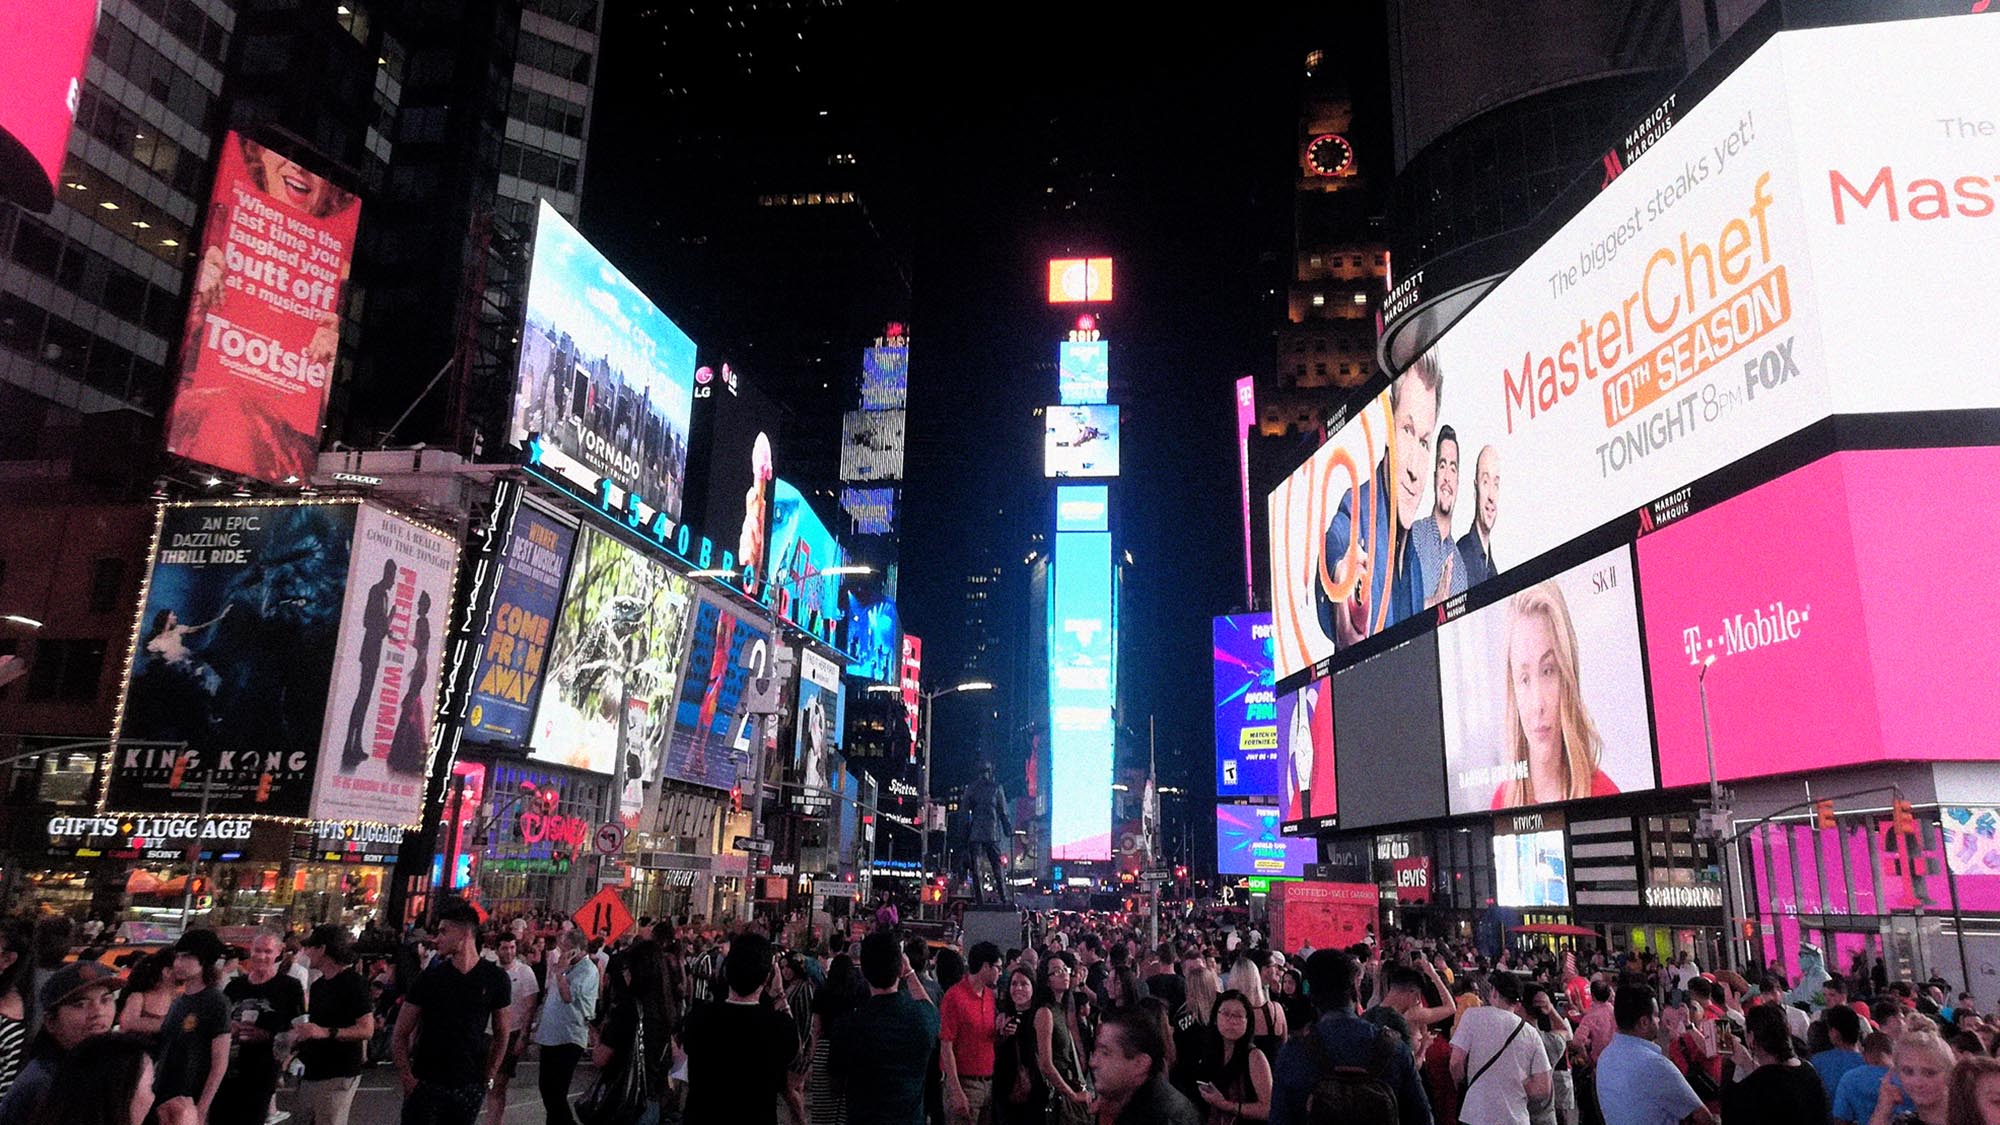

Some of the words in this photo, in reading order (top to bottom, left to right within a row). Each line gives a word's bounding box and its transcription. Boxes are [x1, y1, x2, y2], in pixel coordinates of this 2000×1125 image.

[1626, 94, 1677, 149] MARRIOTT
[1627, 117, 1672, 165] MARQUIS
[1937, 117, 1995, 138] The
[1548, 272, 1577, 299] The
[1580, 208, 1642, 277] biggest
[1647, 156, 1710, 223] steaks
[1716, 112, 1756, 174] yet!
[1829, 166, 2000, 225] Mas
[229, 224, 300, 267] laughed
[300, 259, 338, 284] your
[233, 205, 265, 233] last
[270, 224, 307, 252] time
[310, 243, 340, 269] you
[287, 216, 315, 240] was
[319, 230, 342, 253] the
[225, 242, 289, 292] butt
[291, 278, 335, 310] off
[226, 275, 243, 290] at
[245, 283, 255, 295] a
[1384, 271, 1424, 310] MARRIOTT
[1385, 290, 1418, 325] MARQUIS
[1503, 170, 1774, 434] MasterChef
[205, 313, 327, 388] Tootsie
[1069, 330, 1100, 342] 2019
[1654, 274, 1786, 391] SEASON
[694, 387, 711, 398] LG
[1596, 391, 1699, 478] TONIGHT
[1743, 336, 1801, 401] FOX
[577, 422, 640, 480] VORNADO
[585, 452, 608, 472] REALTY
[610, 468, 629, 485] TRUST
[602, 478, 690, 556] 1540
[1655, 487, 1692, 513] MARRIOTT
[1656, 502, 1689, 525] MARQUIS
[172, 532, 241, 547] DAZZLING
[367, 528, 392, 548] GOOD
[394, 540, 414, 556] TIME
[416, 549, 451, 572] TONIGHT
[382, 519, 404, 539] HAVE
[412, 532, 441, 553] REALLY
[161, 549, 207, 564] THRILL
[511, 535, 536, 564] BEST
[530, 543, 564, 579] MUSICAL
[496, 601, 550, 647] COME
[487, 633, 544, 676] FROM
[478, 664, 538, 705] AWAY
[372, 666, 405, 760] WOMAN
[123, 749, 200, 770] KING
[219, 751, 307, 771] KONG
[1226, 767, 1235, 779] T
[48, 817, 118, 837] GIFTS
[136, 819, 253, 839] LUGGAGE
[352, 823, 404, 844] LUGGAGE
[1513, 814, 1544, 831] INVICTA
[147, 850, 182, 859] SONY
